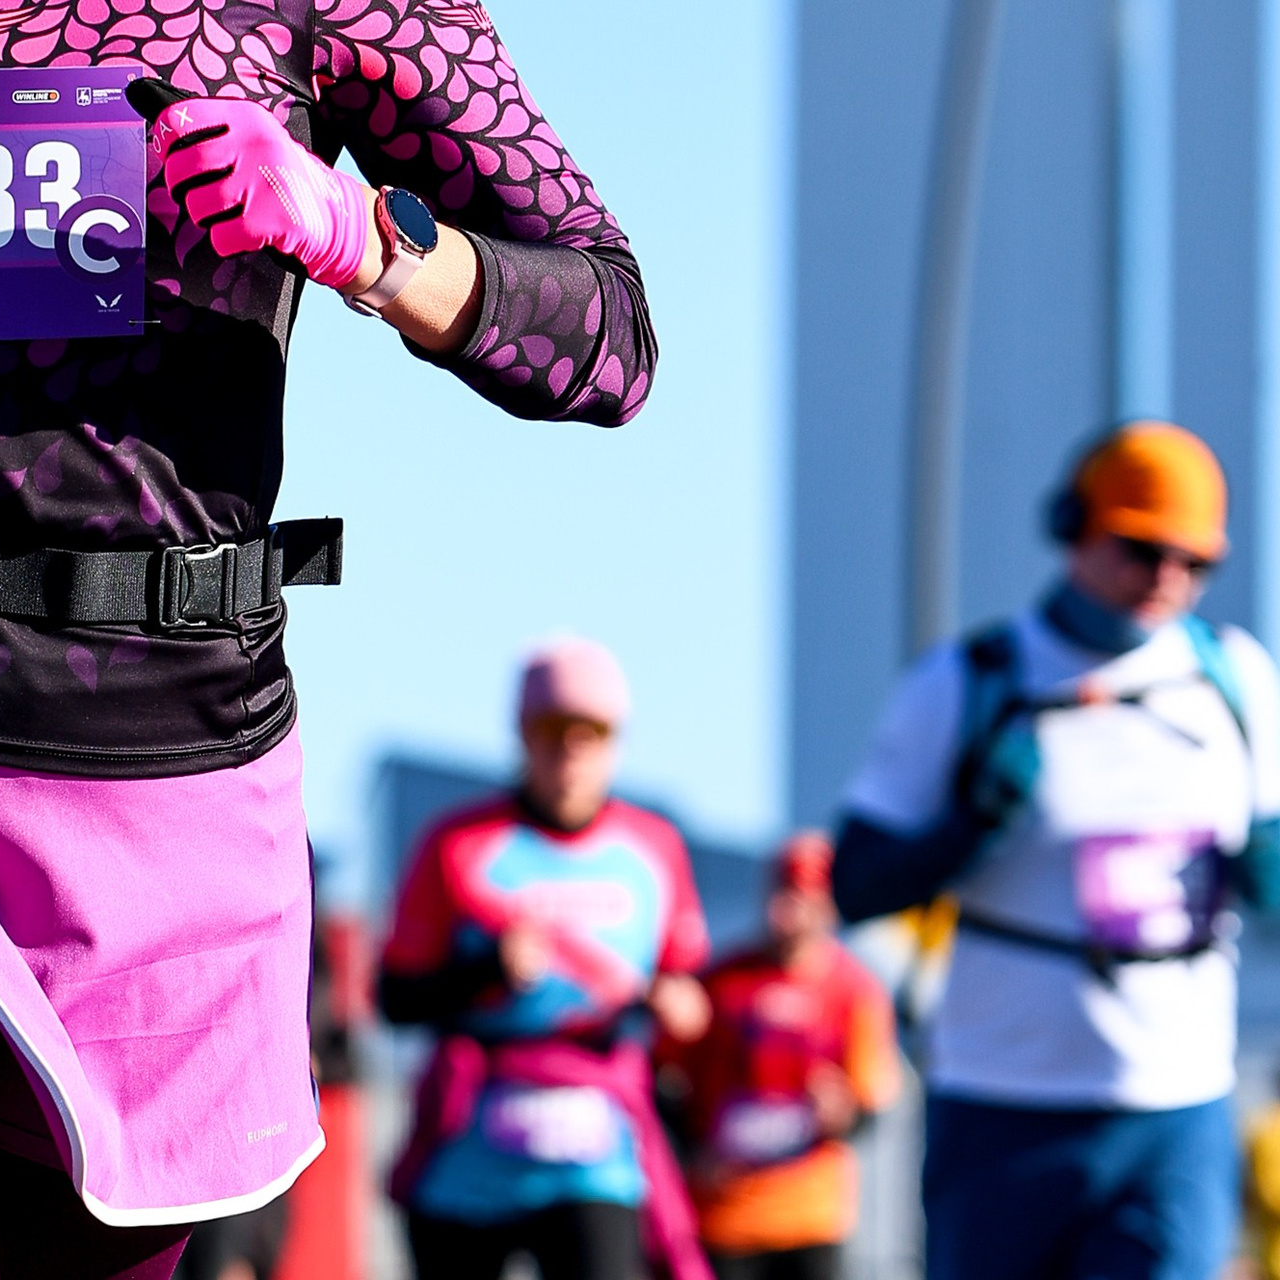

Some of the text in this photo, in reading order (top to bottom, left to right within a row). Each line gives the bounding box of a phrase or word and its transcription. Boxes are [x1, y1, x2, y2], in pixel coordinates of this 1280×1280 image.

[15, 92, 49, 101] WINLINE
[153, 106, 194, 153] OAX
[69, 208, 130, 273] C
